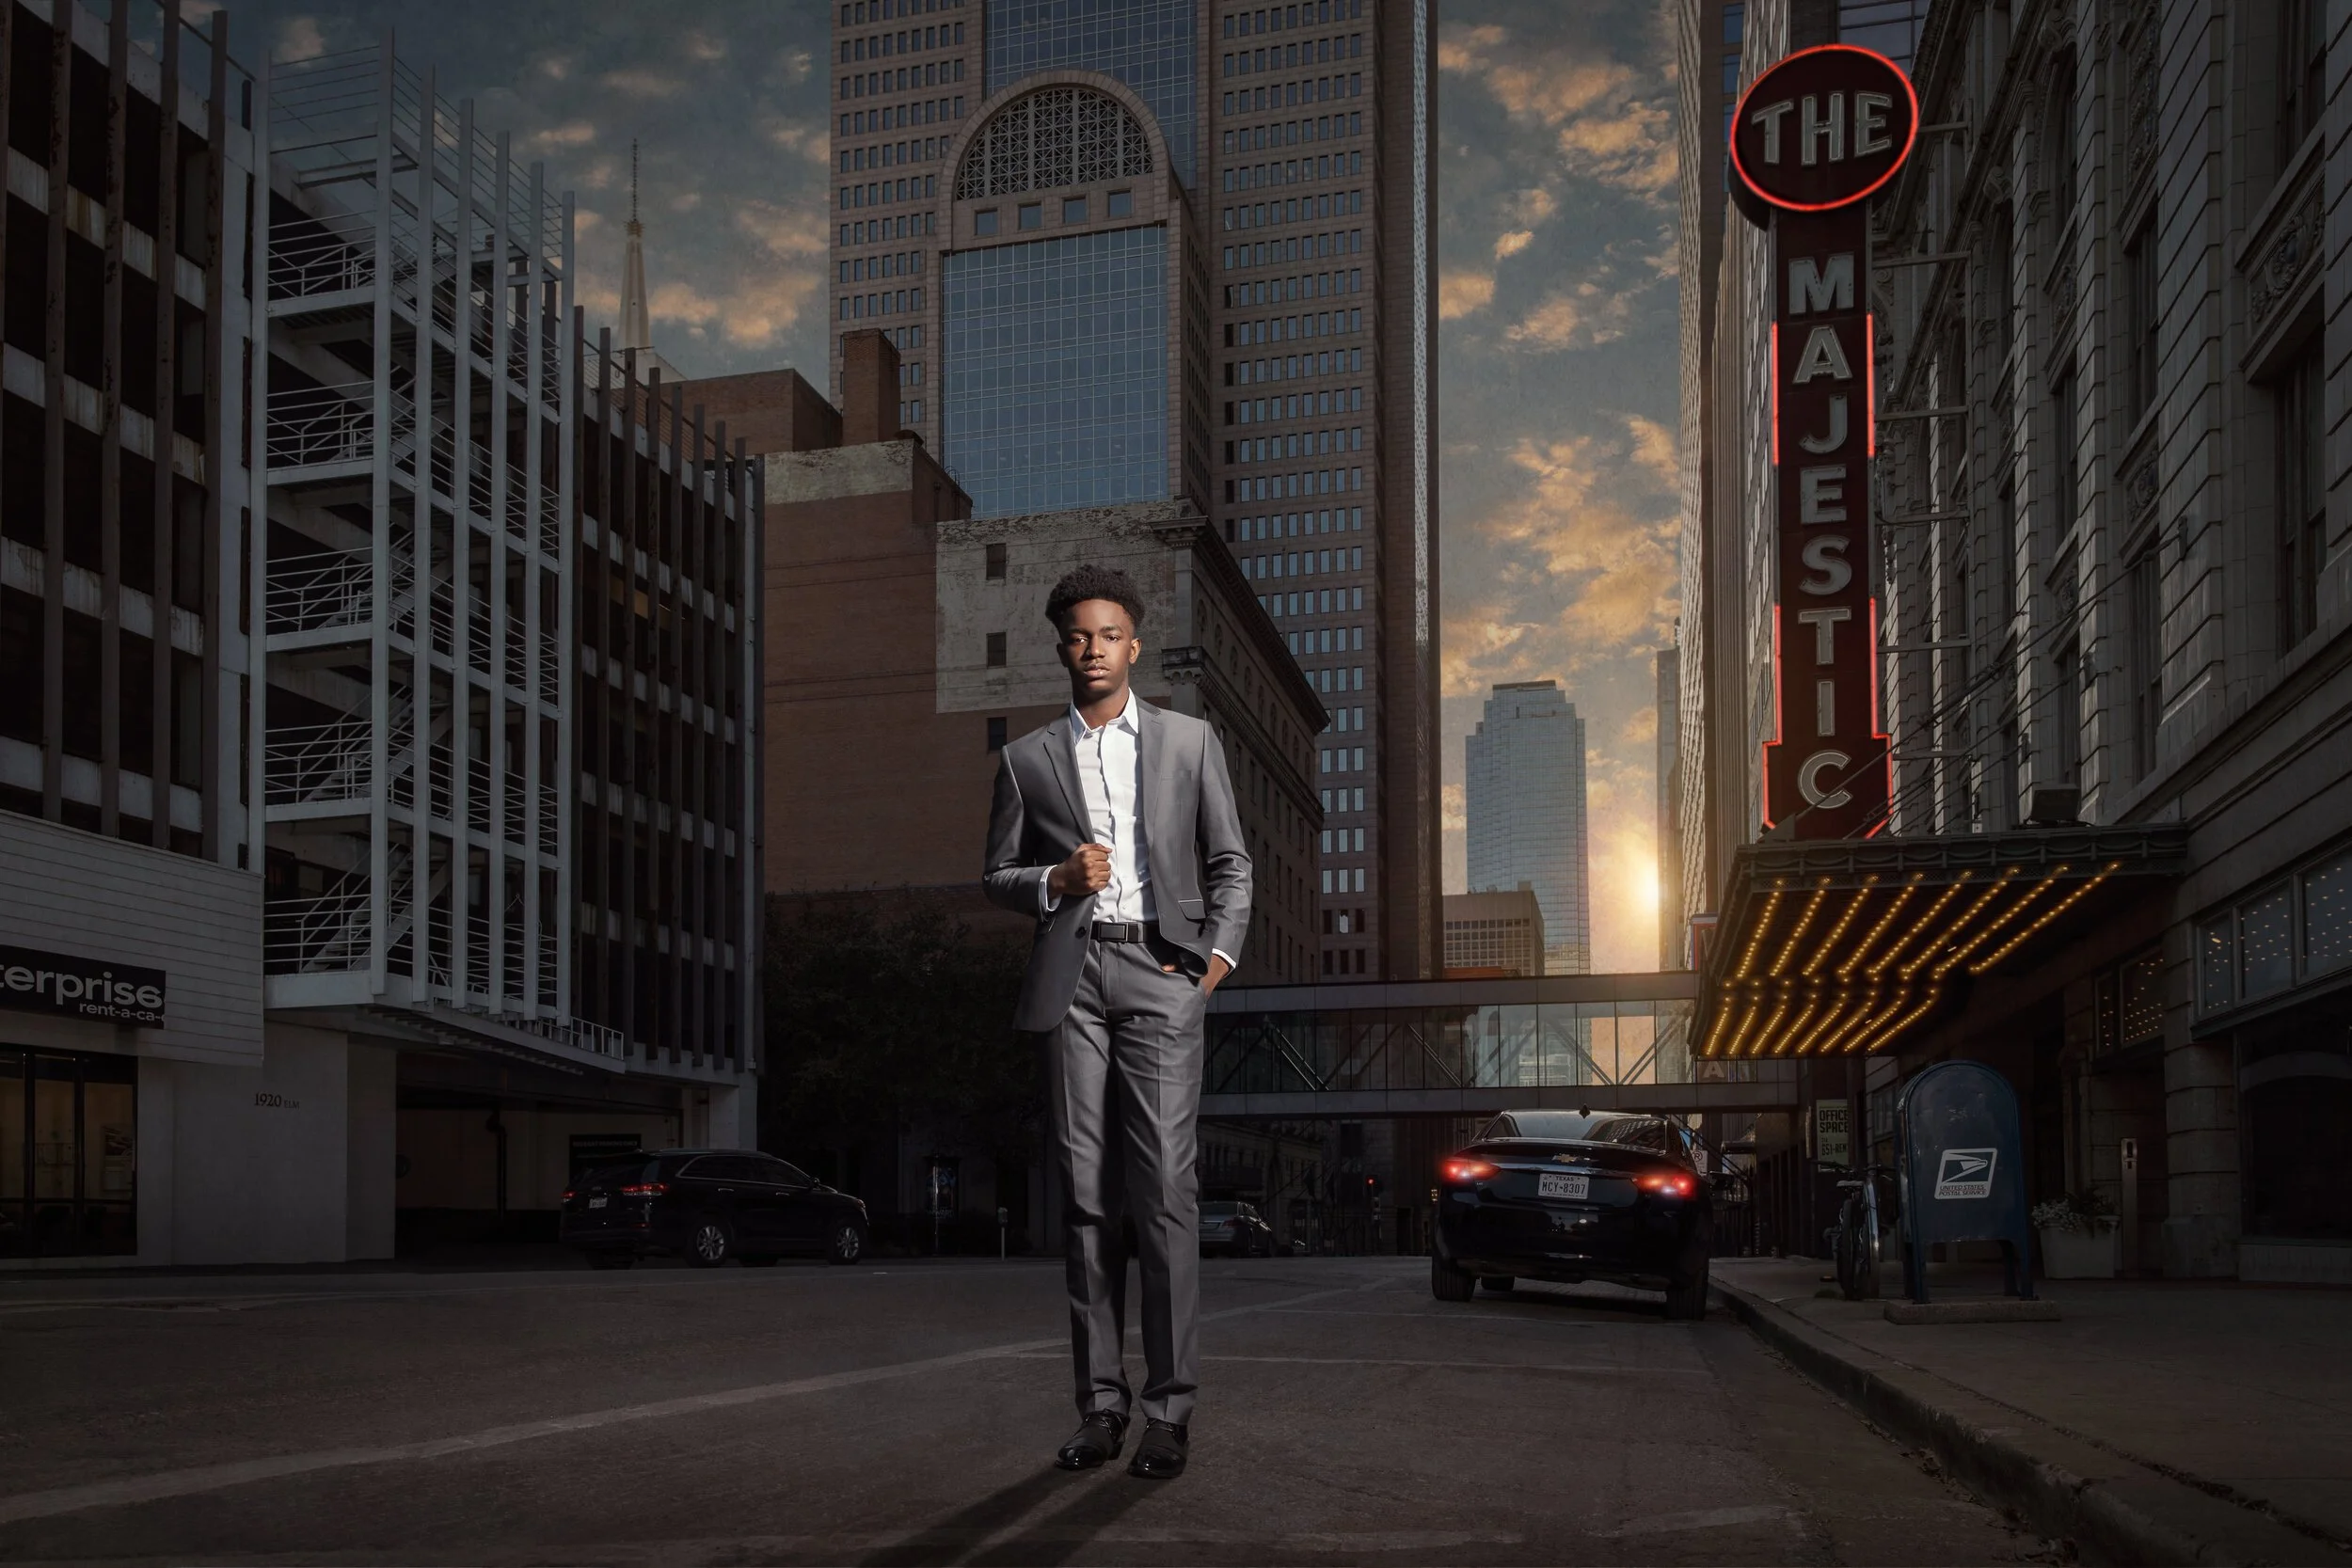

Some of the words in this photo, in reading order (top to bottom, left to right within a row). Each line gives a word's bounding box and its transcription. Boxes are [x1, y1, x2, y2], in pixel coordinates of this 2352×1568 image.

[1751, 90, 1894, 167] THE
[1788, 251, 1855, 809] MAJESTIC
[254, 1092, 281, 1108] 1920
[284, 1100, 300, 1110] ELM
[1820, 1109, 1848, 1121] OFFICE
[1820, 1122, 1848, 1133] SPACE
[1821, 1143, 1848, 1156] 651-REN
